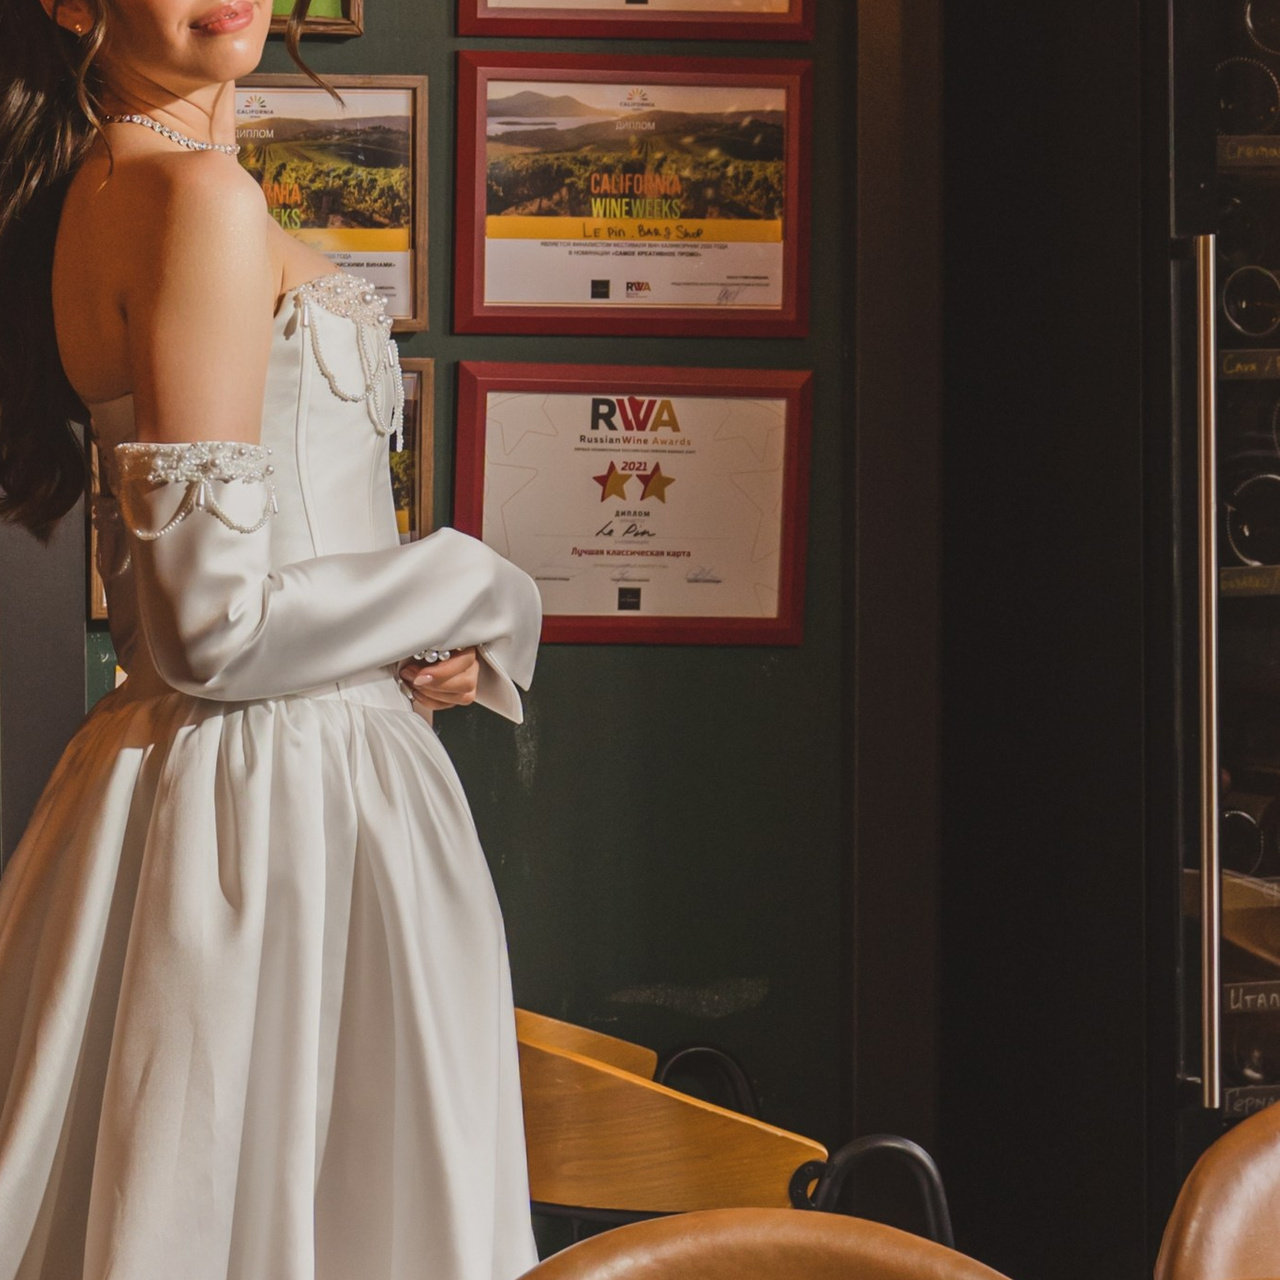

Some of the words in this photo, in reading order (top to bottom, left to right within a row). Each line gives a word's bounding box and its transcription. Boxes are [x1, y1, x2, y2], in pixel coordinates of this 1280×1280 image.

[615, 122, 656, 131] ДИПЛОМ
[591, 173, 681, 194] CALIFORNIA
[591, 396, 681, 432] RWA
[653, 437, 691, 446] Awards
[621, 461, 647, 471] 2021
[571, 547, 604, 558] Лучшая
[606, 548, 664, 558] классическая
[666, 549, 691, 559] карта
